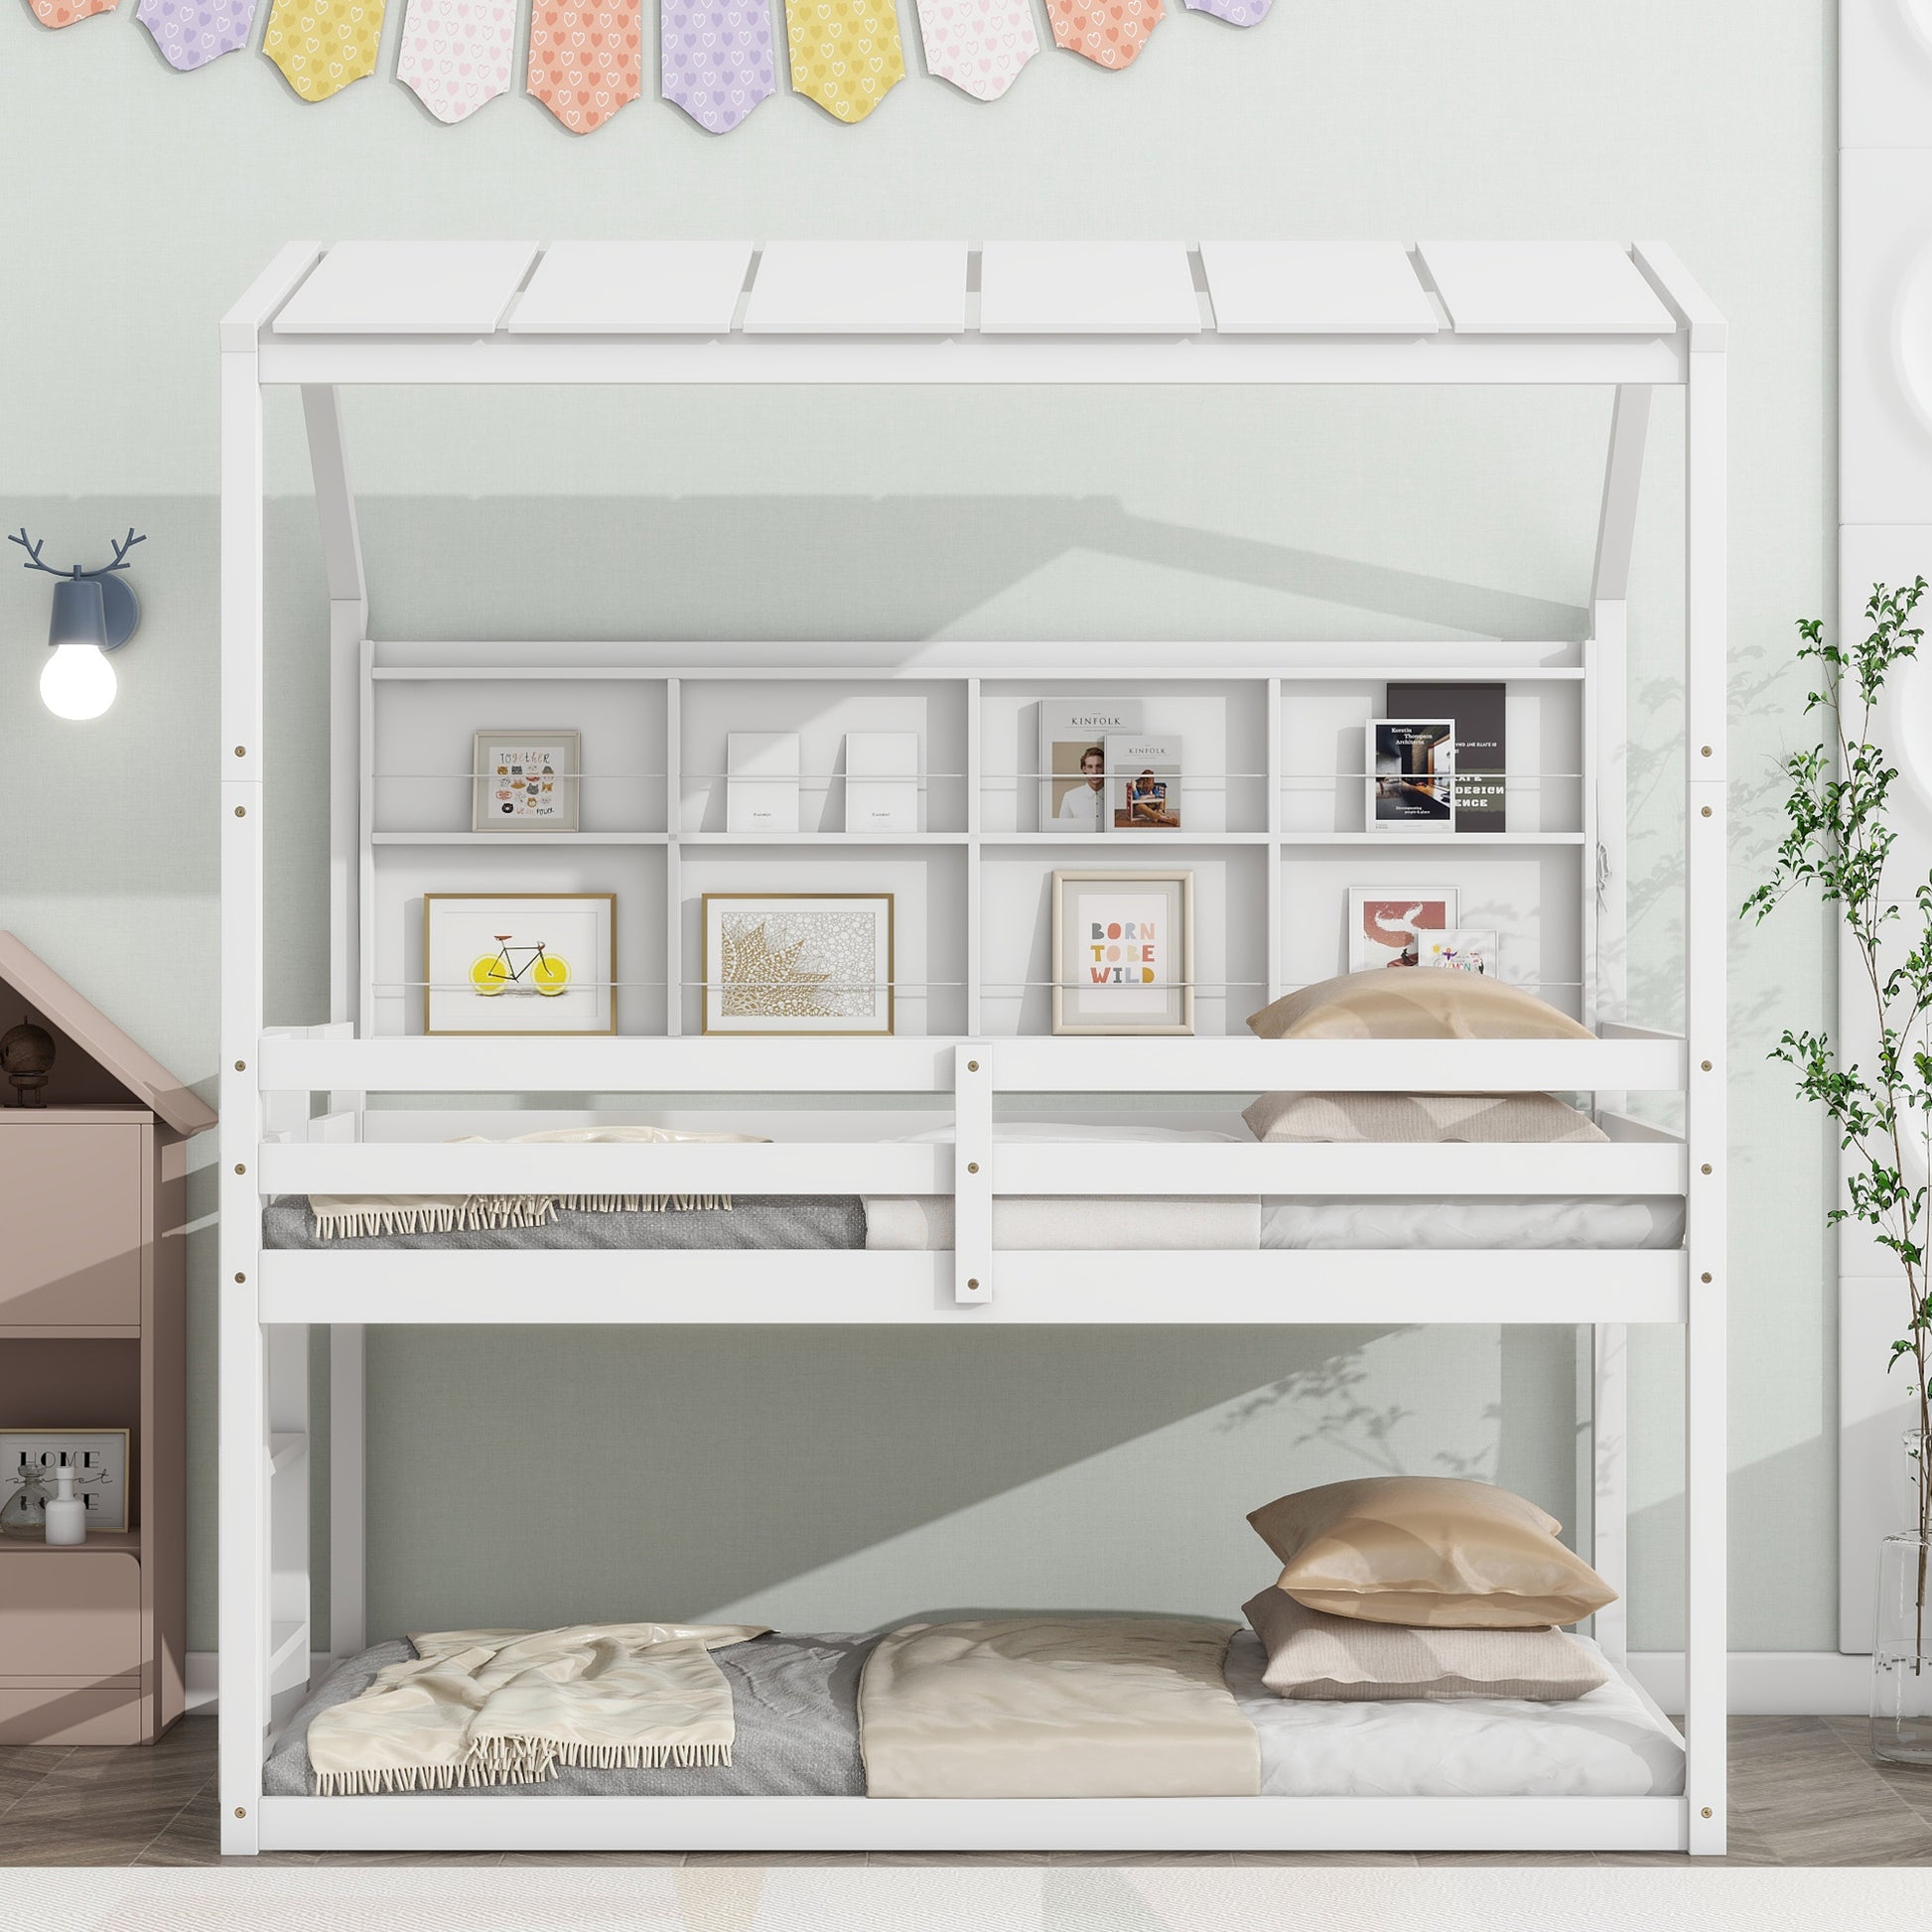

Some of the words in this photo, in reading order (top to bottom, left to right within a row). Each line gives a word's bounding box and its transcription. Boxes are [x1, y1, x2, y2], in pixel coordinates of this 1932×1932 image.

[1091, 922, 1155, 940] BORN
[1090, 945, 1121, 962] TO
[1127, 945, 1155, 962] BE
[1090, 967, 1155, 984] WILD
[18, 1450, 100, 1468] HOME
